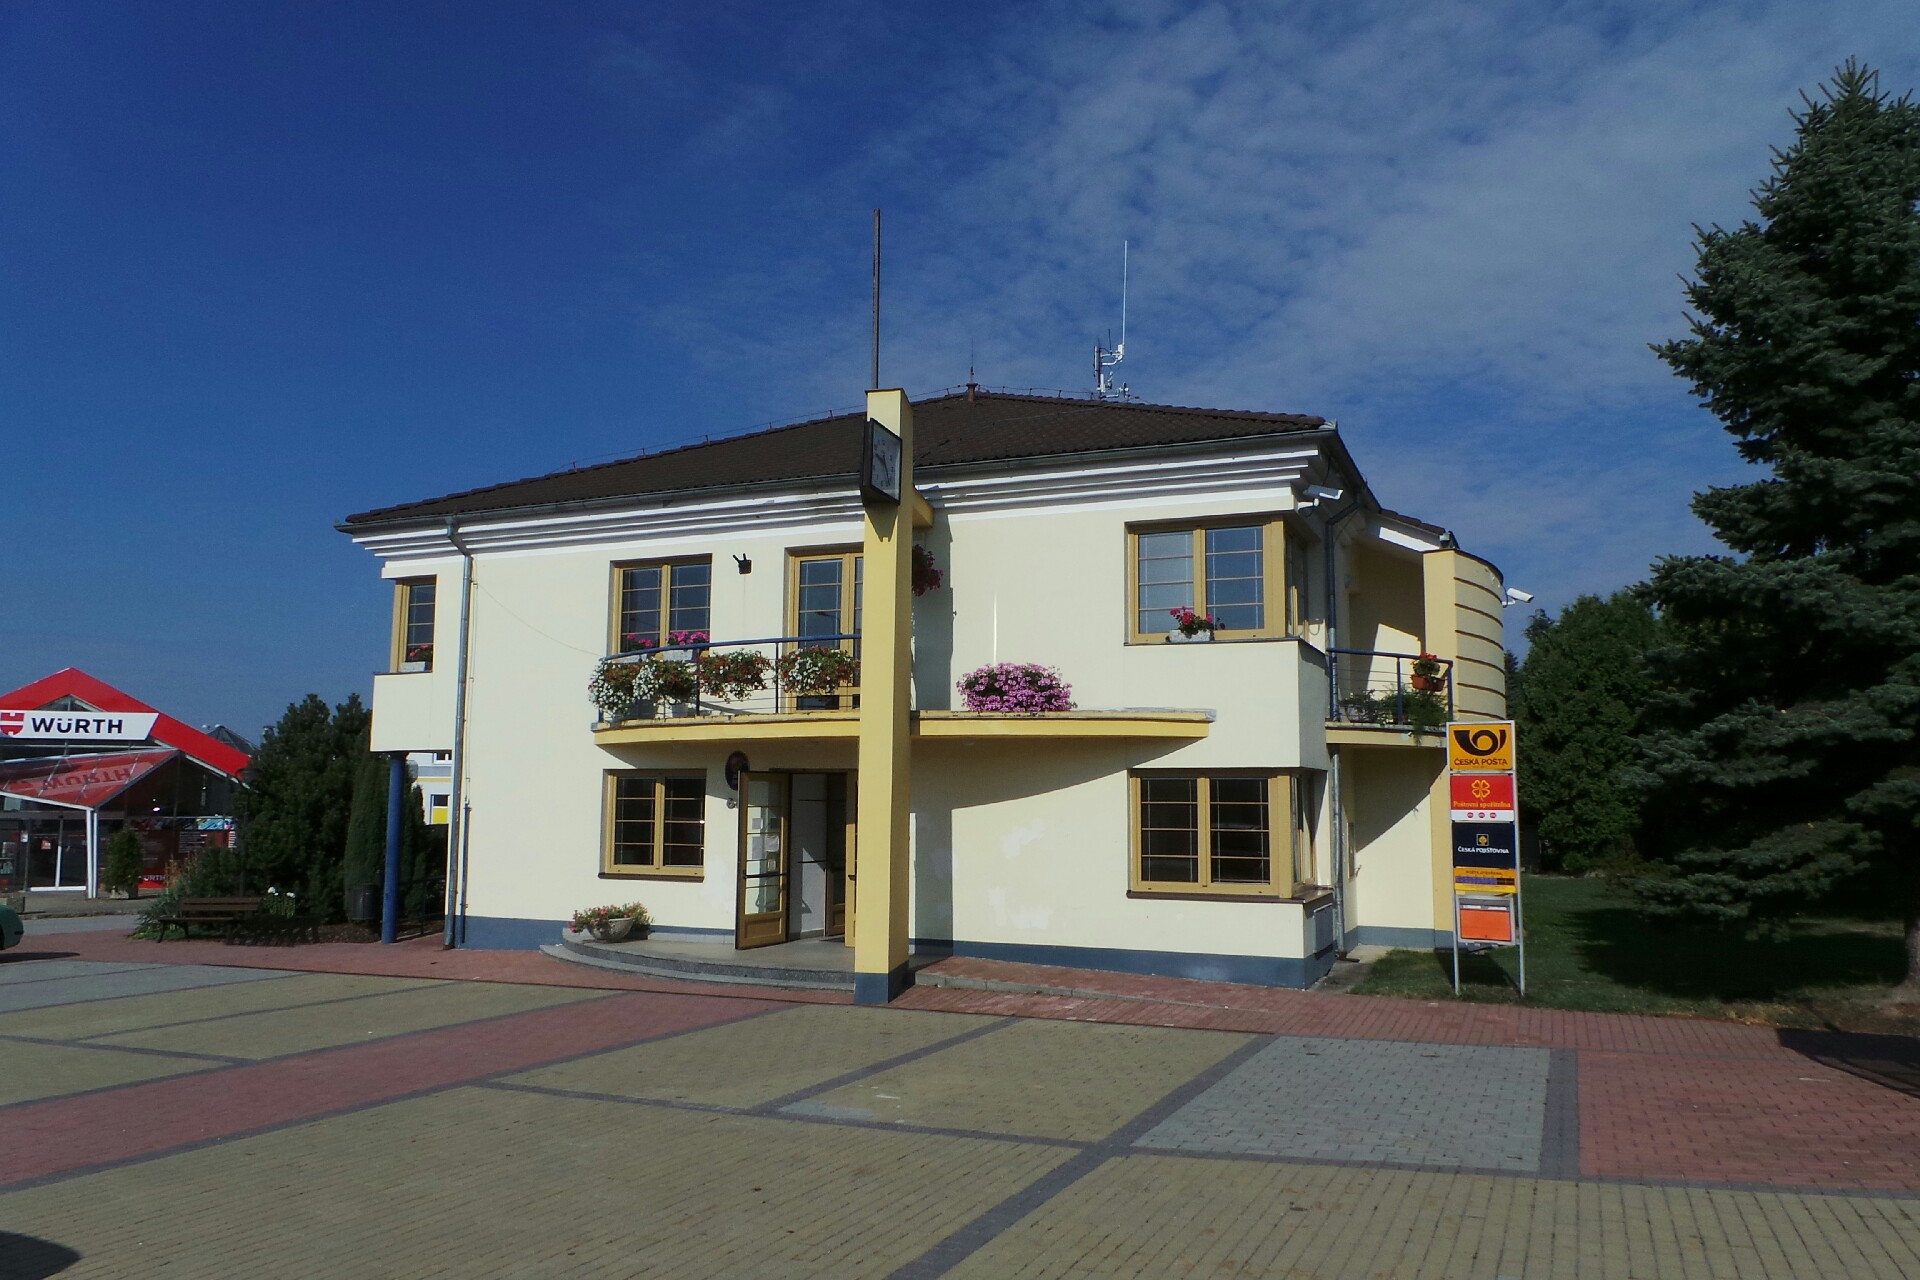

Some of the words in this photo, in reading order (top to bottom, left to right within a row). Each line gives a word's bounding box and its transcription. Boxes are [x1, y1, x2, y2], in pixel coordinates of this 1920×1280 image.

[32, 717, 123, 734] WÜRTH
[1454, 758, 1479, 766] ČESKÁ
[1481, 758, 1508, 766] POŠTA
